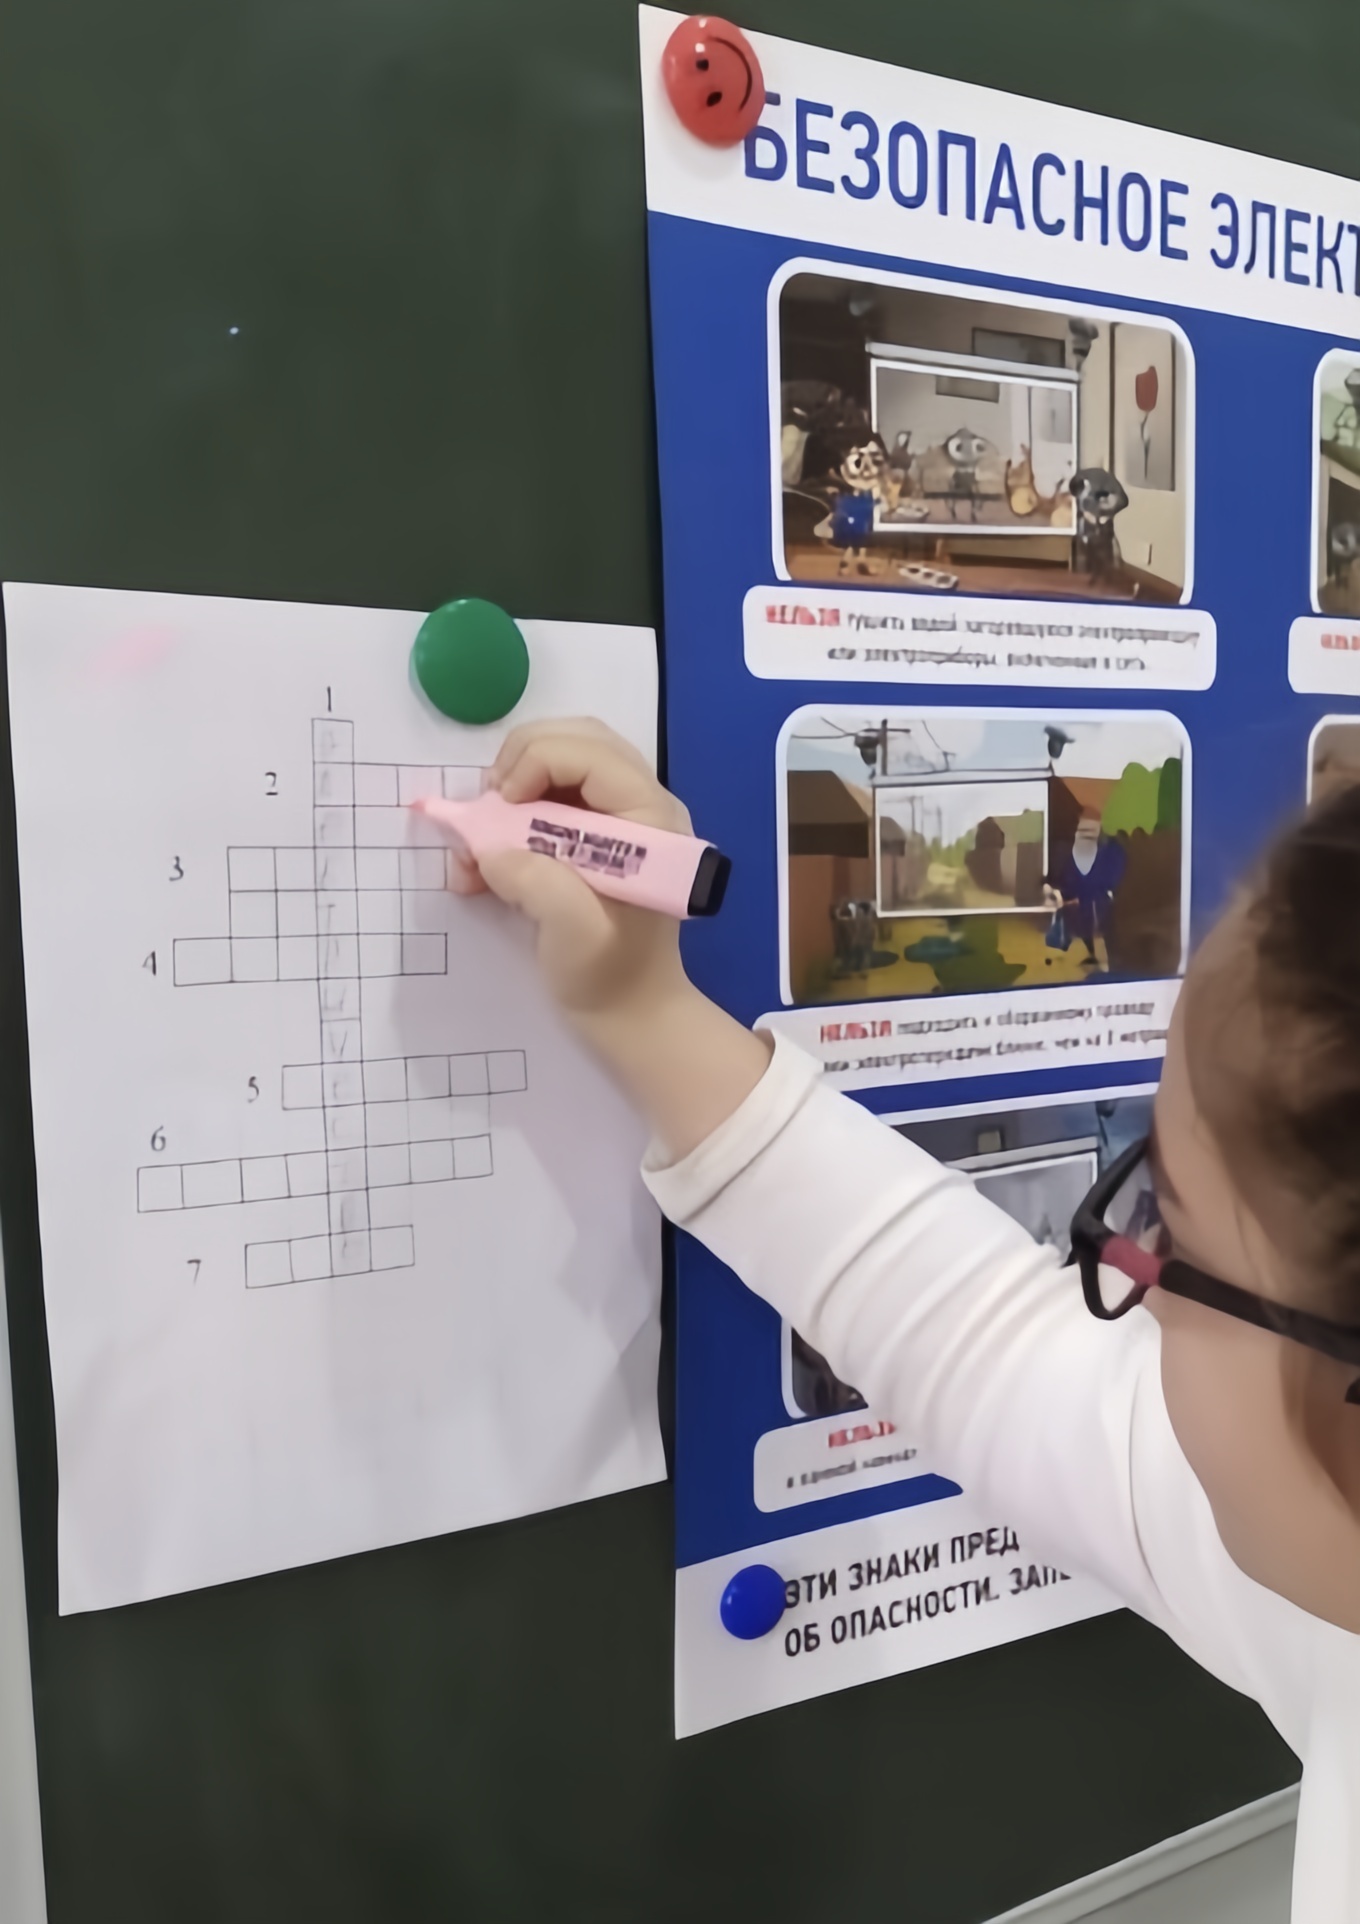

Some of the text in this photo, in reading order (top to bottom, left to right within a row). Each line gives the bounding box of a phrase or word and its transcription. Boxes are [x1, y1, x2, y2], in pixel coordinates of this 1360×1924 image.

[743, 91, 1190, 262] БЕЗОПАСНОЕ
[264, 771, 280, 797] 2
[168, 855, 186, 882] 3
[247, 1075, 261, 1104] 5
[149, 1125, 168, 1152] 6
[186, 1258, 203, 1285] 7
[784, 1568, 838, 1610] ЭТИ
[847, 1542, 940, 1592] ЗНАКИ
[784, 1622, 821, 1658] ОБ
